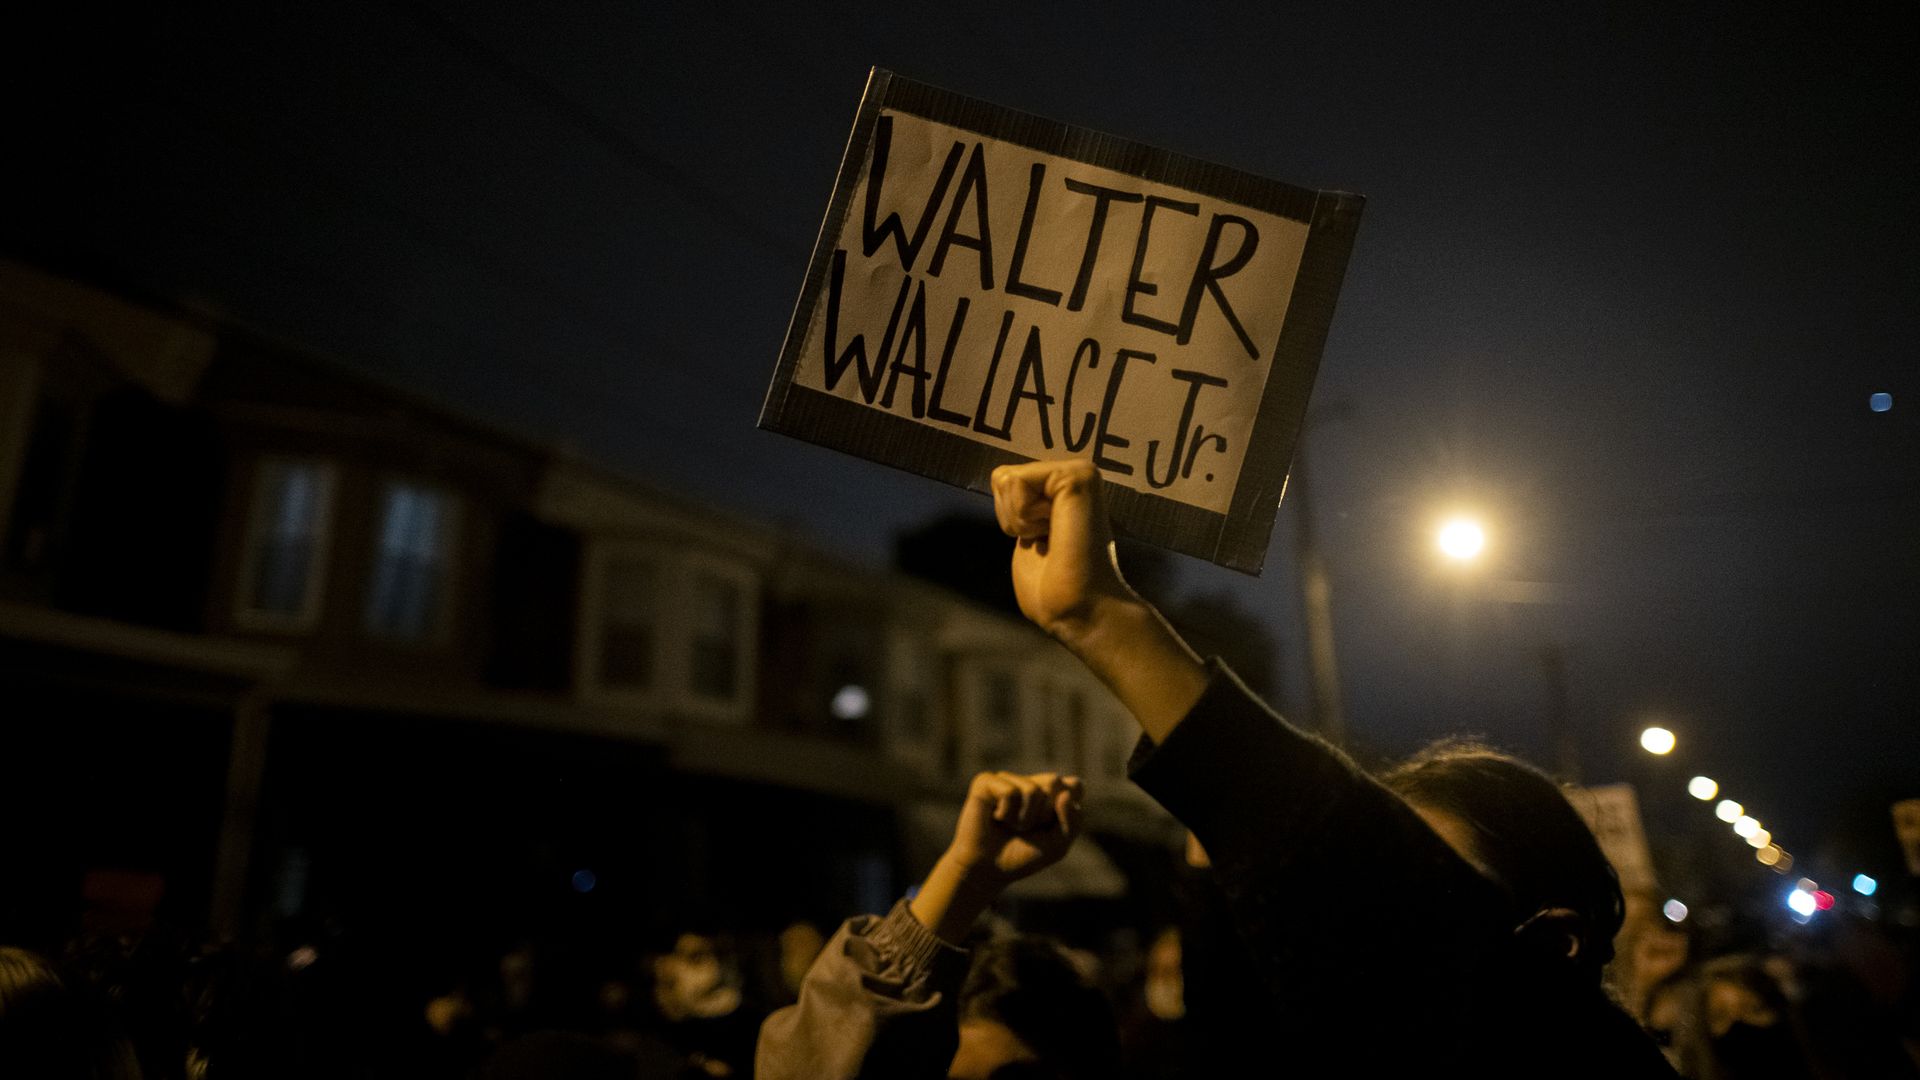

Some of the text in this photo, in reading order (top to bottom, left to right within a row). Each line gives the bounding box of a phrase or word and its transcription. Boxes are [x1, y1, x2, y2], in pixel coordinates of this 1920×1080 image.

[863, 116, 1260, 360] WALTER
[824, 249, 1228, 489] WALLACE Jr.
